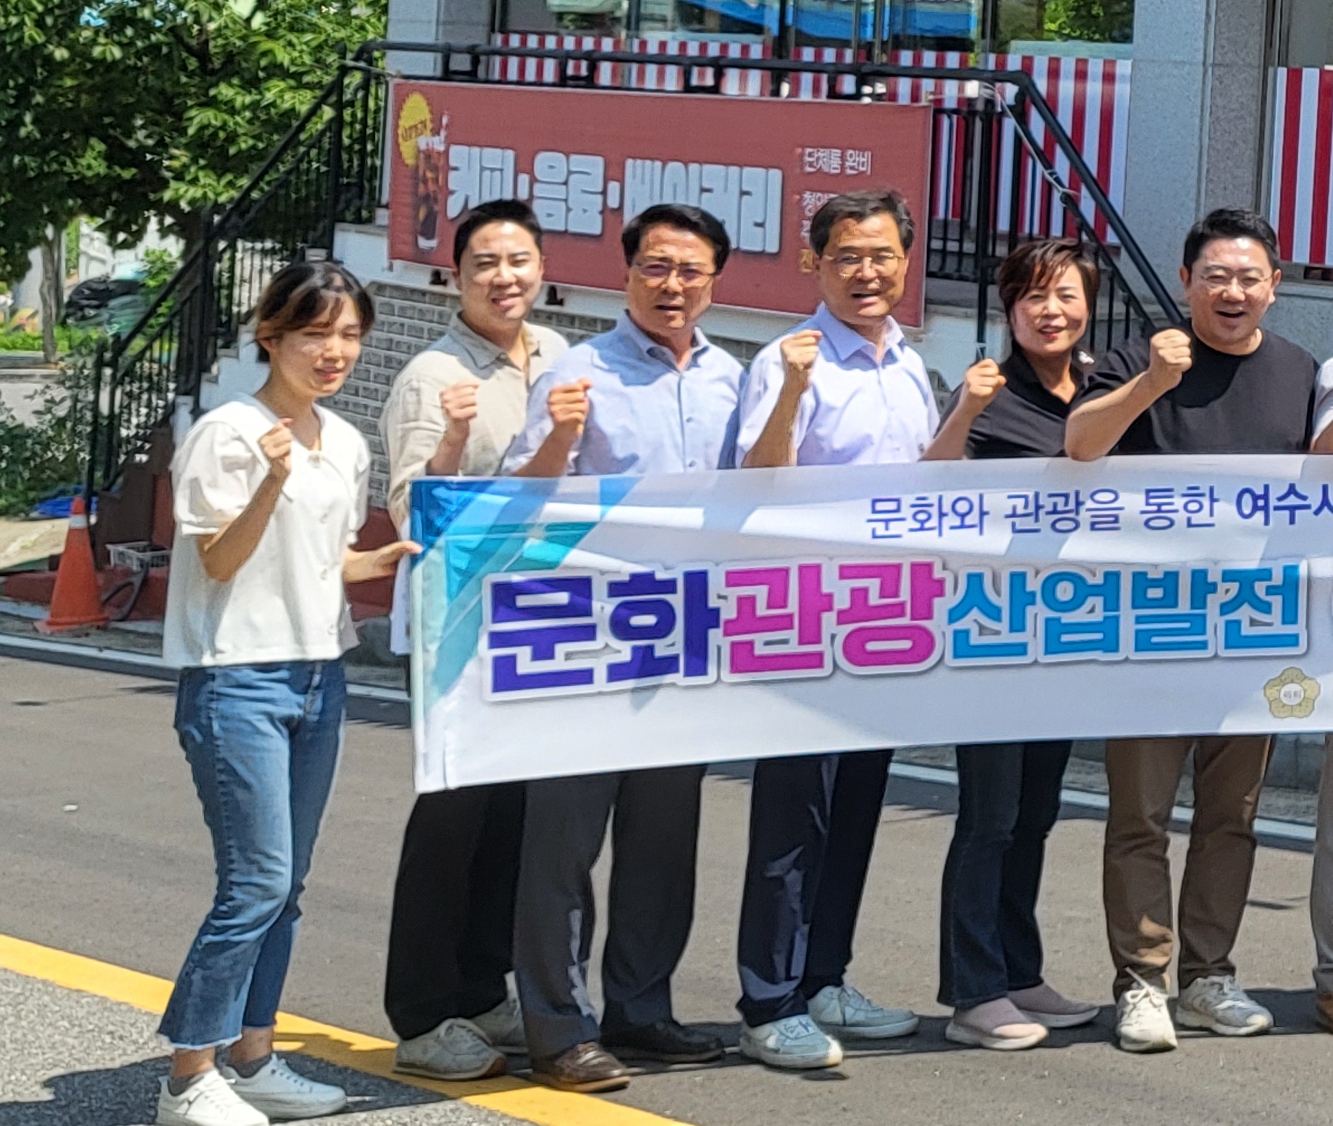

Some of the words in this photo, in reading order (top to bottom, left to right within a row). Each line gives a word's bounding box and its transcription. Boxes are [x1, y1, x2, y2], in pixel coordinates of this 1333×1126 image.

[803, 147, 841, 174] 단체룸
[845, 149, 871, 175] 완비
[866, 491, 989, 541] 문화와
[1003, 487, 1125, 535] 관광을
[1139, 484, 1219, 531] 통한
[486, 558, 1302, 695] 문화관광산업발전
